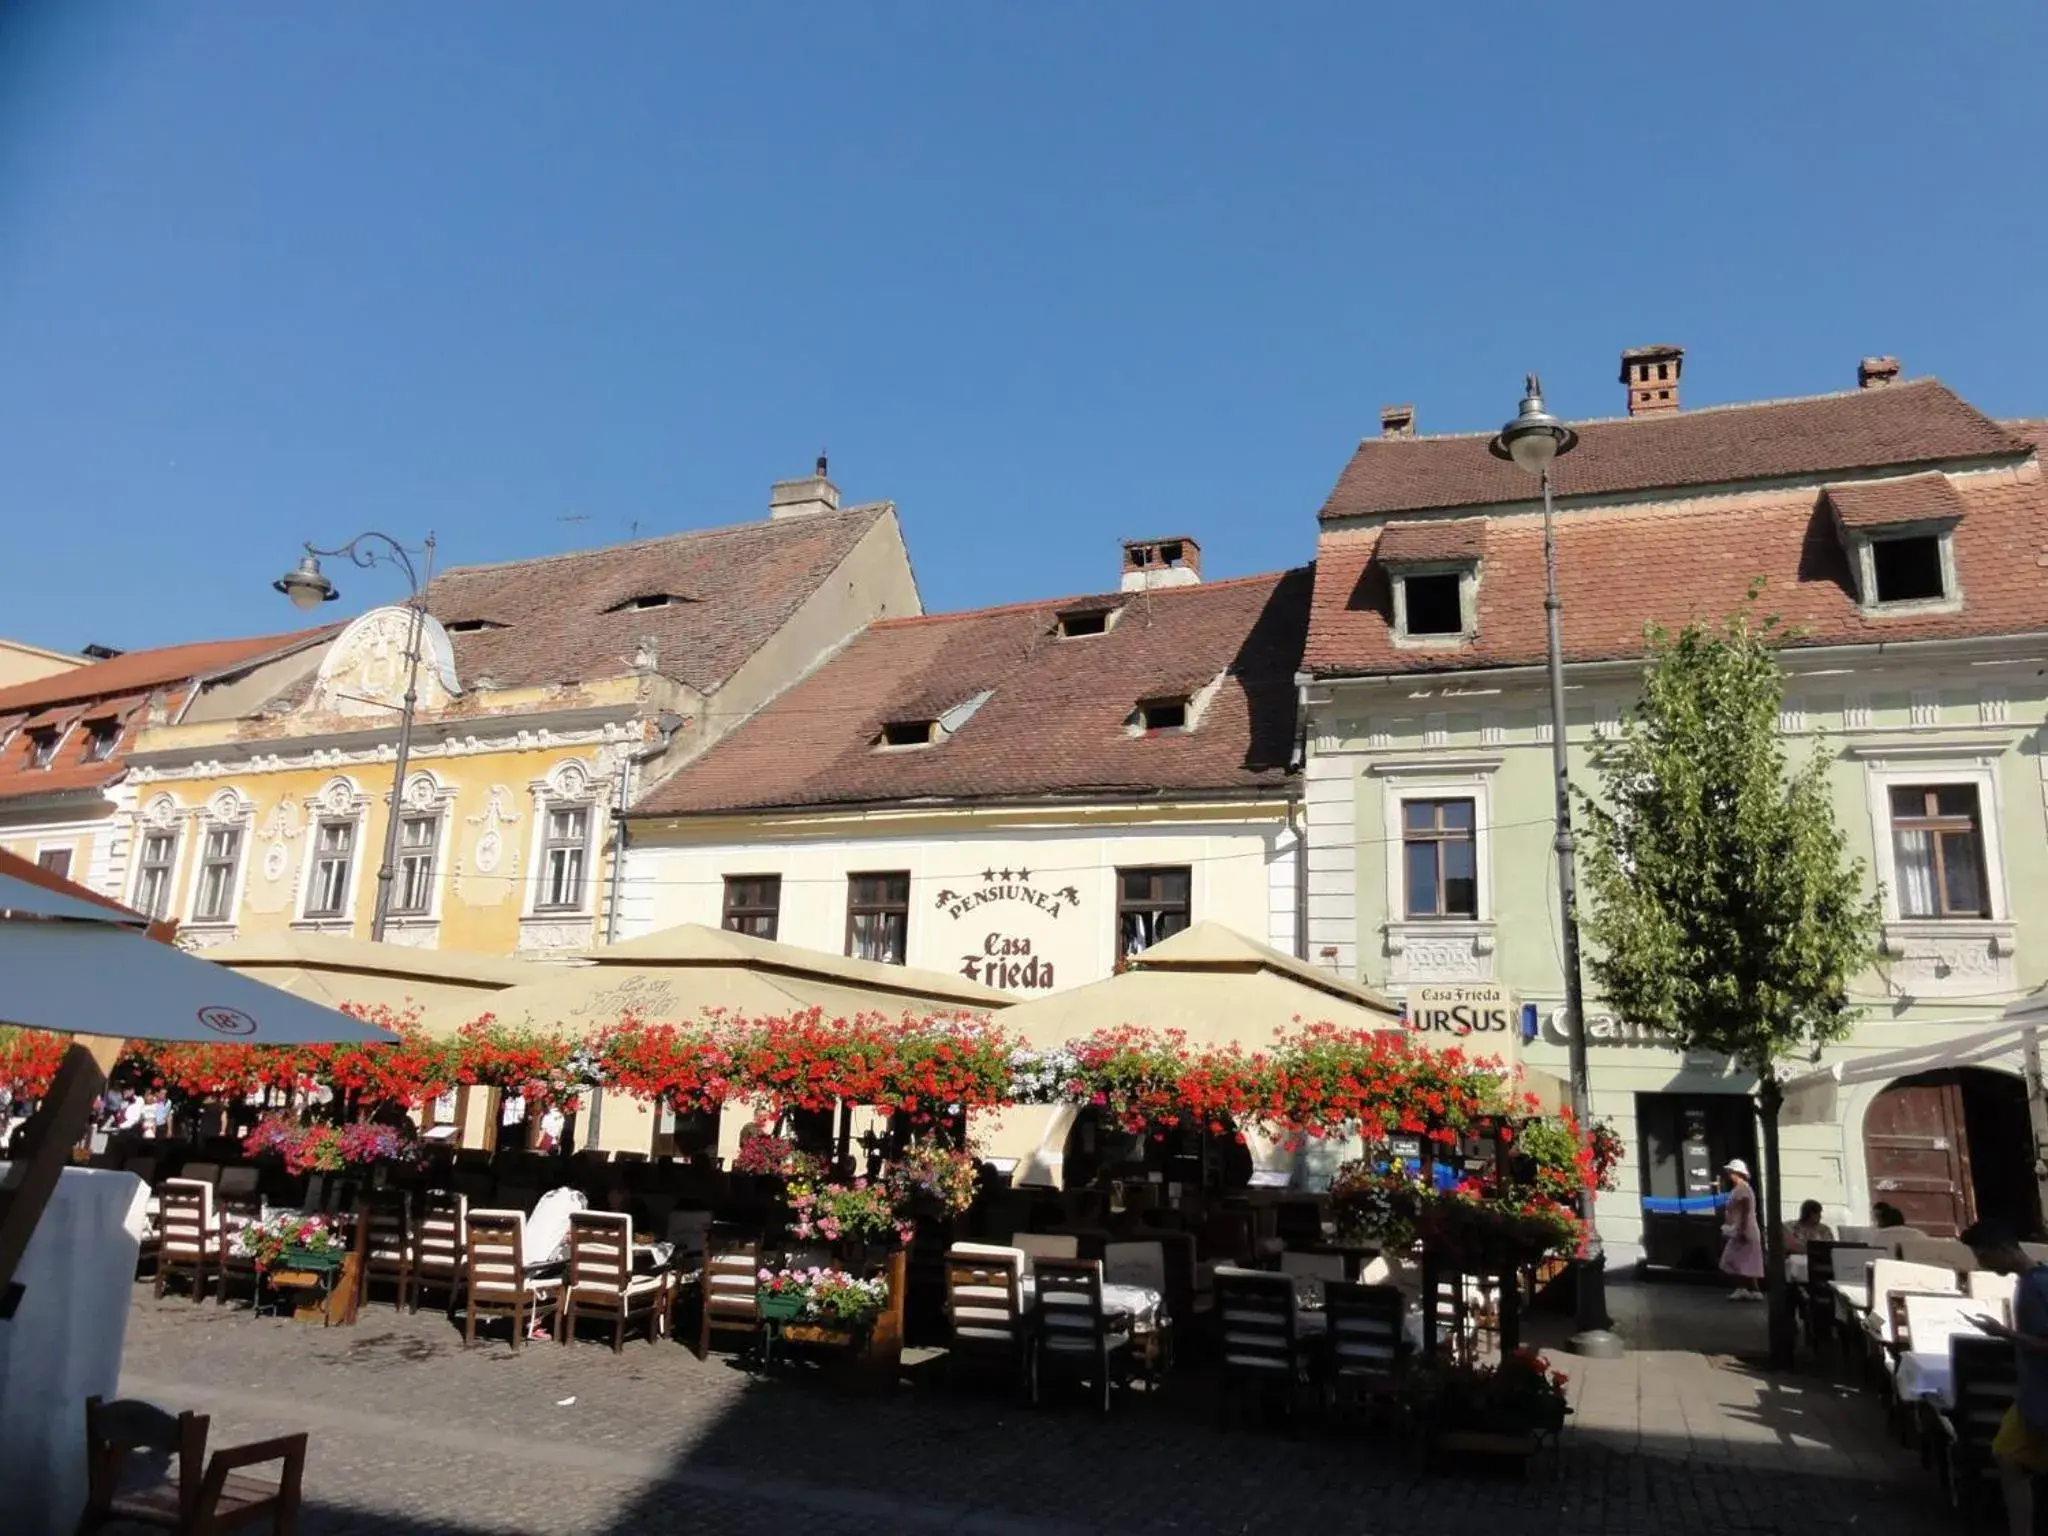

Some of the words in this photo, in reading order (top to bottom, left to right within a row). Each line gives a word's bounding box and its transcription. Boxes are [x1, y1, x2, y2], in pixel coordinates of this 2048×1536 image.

[949, 885, 1061, 920] PENSIUNEA
[984, 932, 1031, 956] Casa
[960, 955, 1054, 989] Frieda
[1421, 988, 1452, 1001] Casa
[1455, 988, 1500, 1001] Frieda
[1414, 1005, 1506, 1037] URSUS
